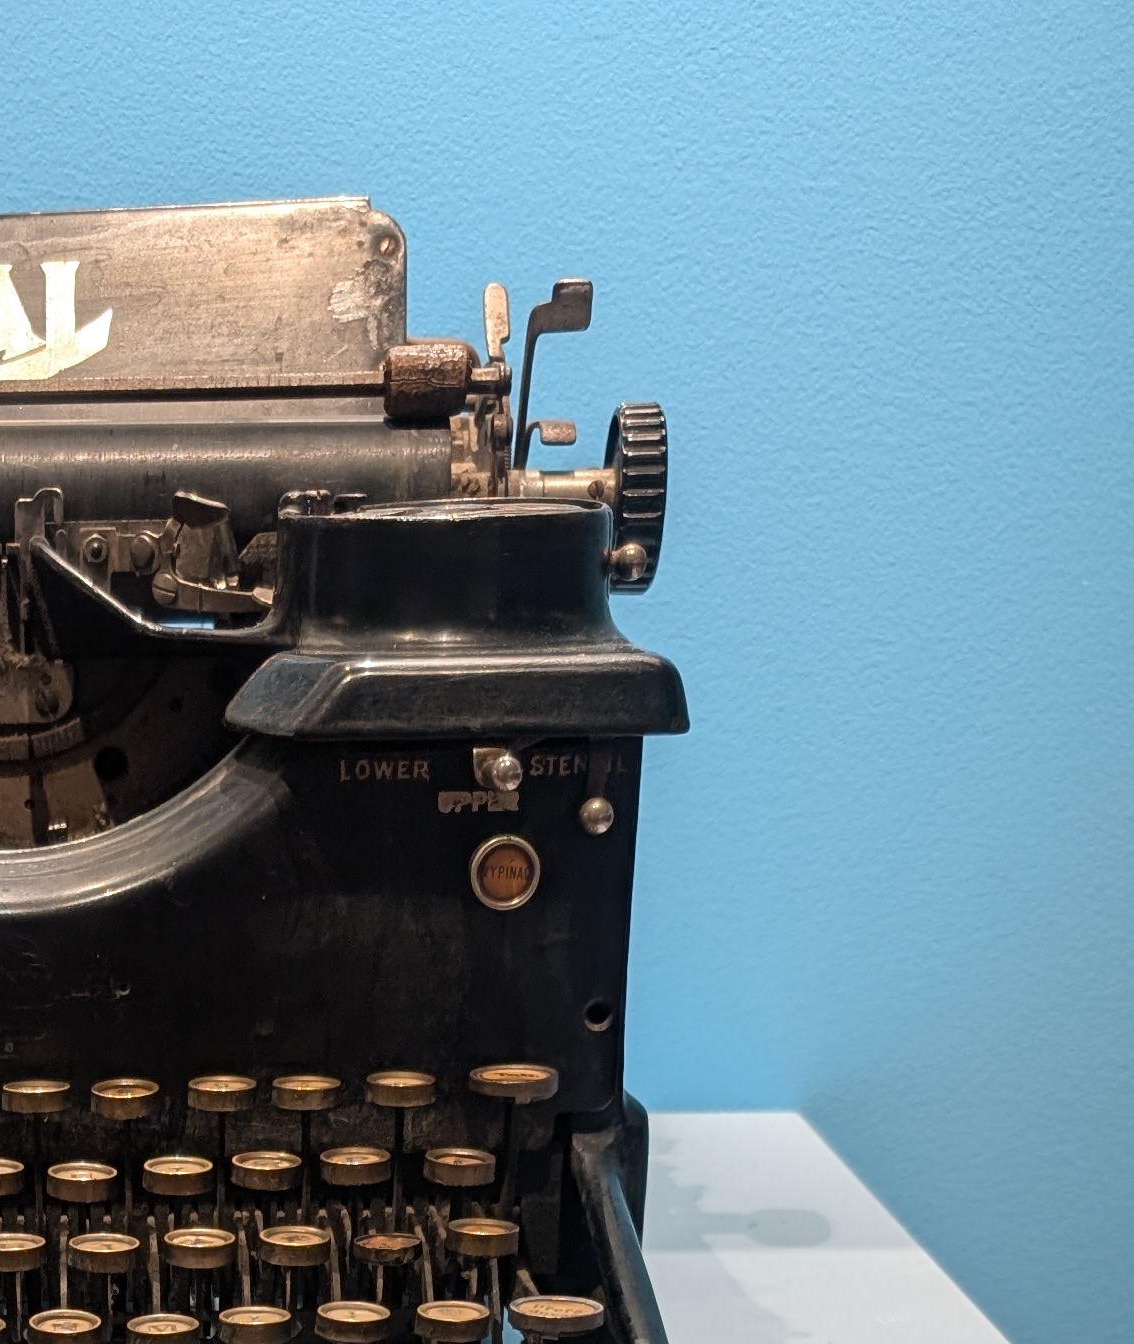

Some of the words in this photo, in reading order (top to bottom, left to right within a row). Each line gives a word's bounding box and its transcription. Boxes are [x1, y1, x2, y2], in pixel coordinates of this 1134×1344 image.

[339, 759, 431, 782] LOWER
[529, 754, 627, 777] STENIL
[437, 791, 520, 813] UPPER
